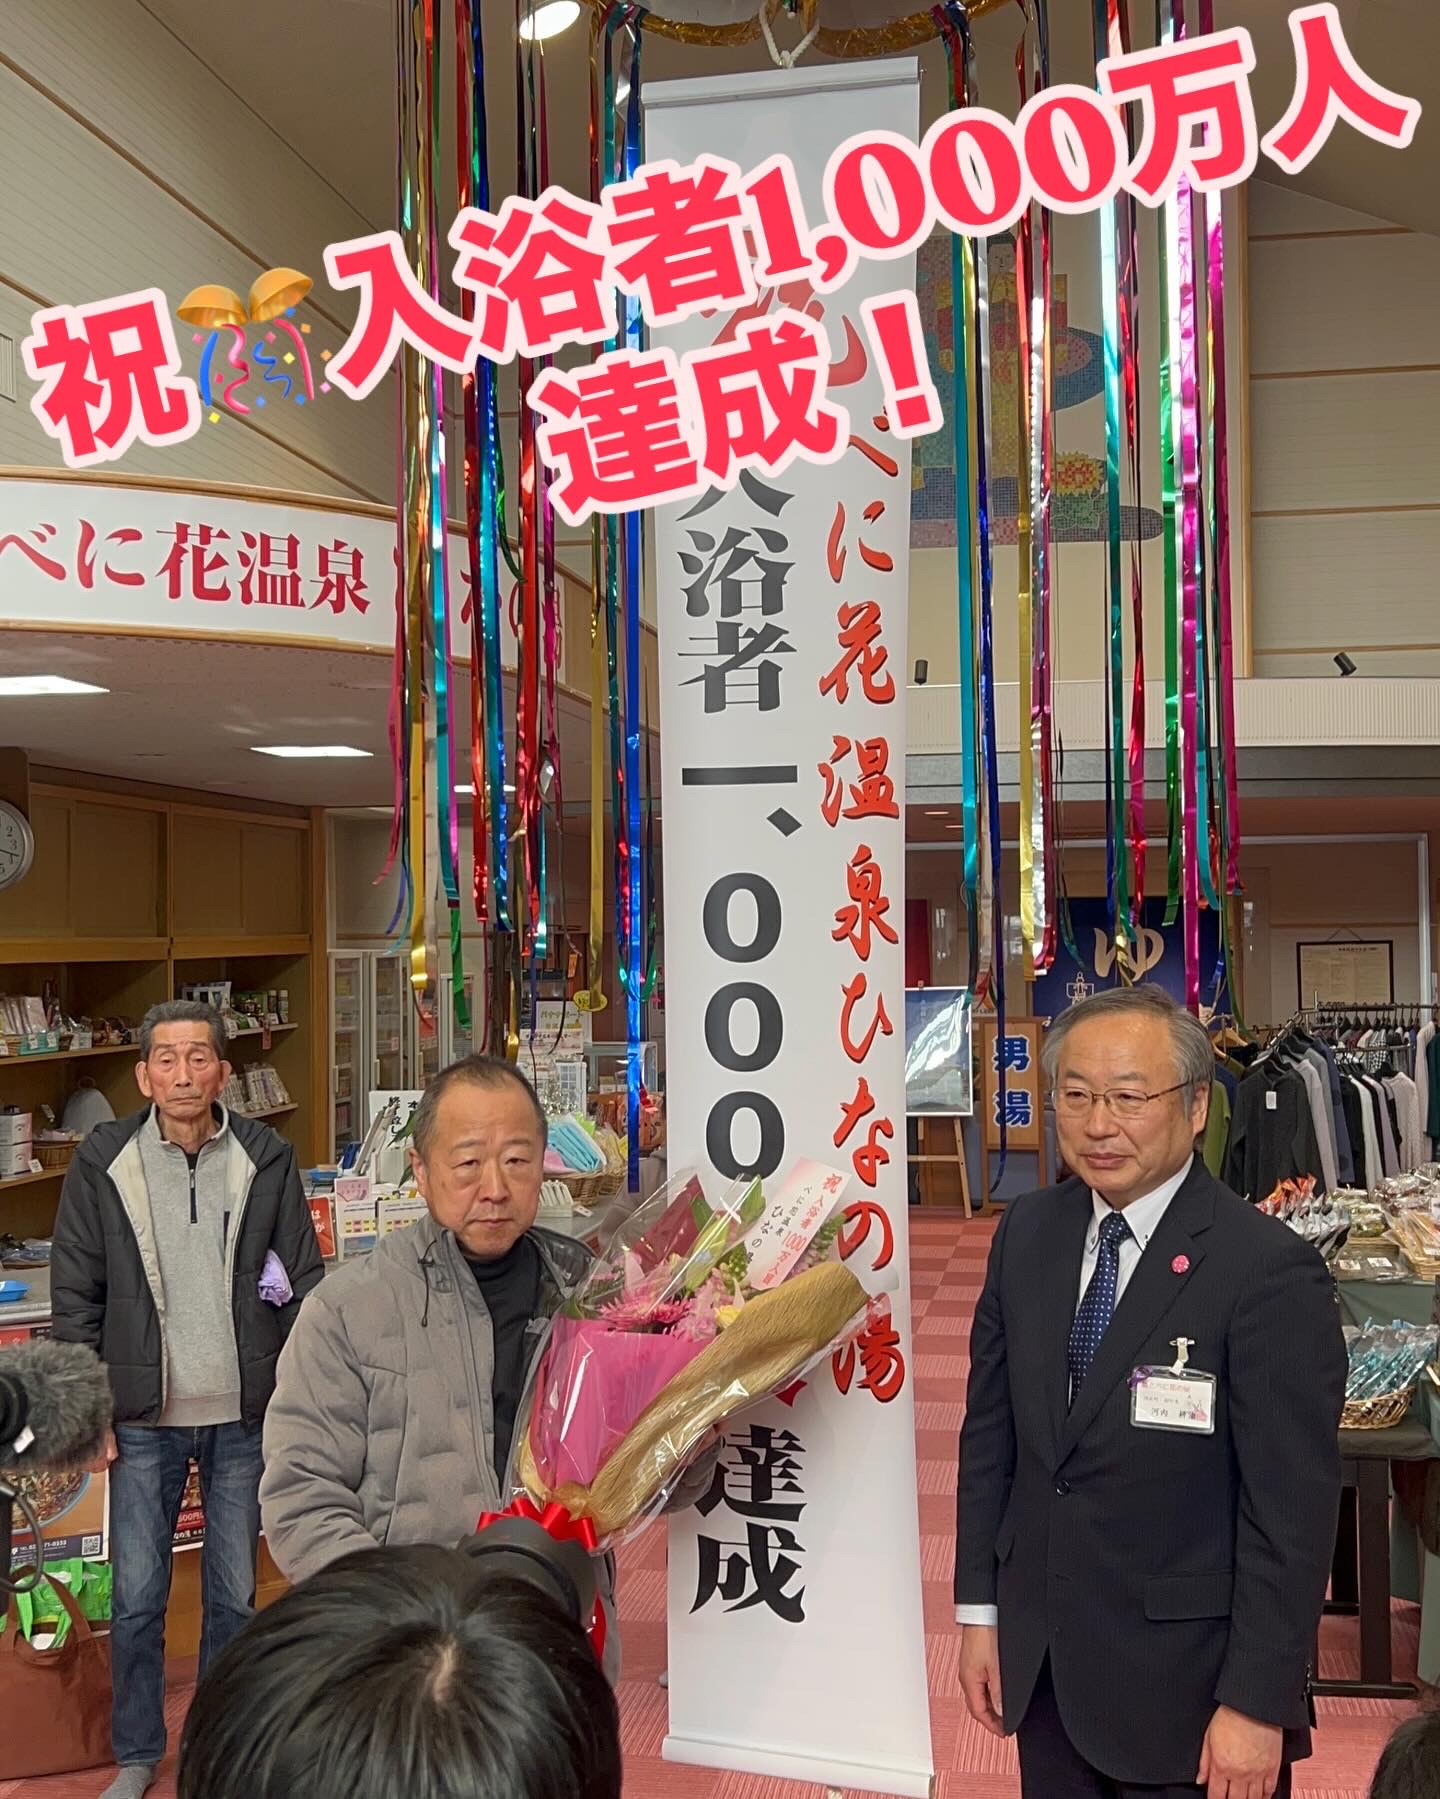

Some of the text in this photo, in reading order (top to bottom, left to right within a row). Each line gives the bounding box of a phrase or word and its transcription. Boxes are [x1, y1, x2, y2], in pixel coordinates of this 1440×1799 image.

[0, 518, 371, 614] べに花温泉
[1094, 921, 1164, 983] ゆ
[992, 1034, 1033, 1128] 男湯
